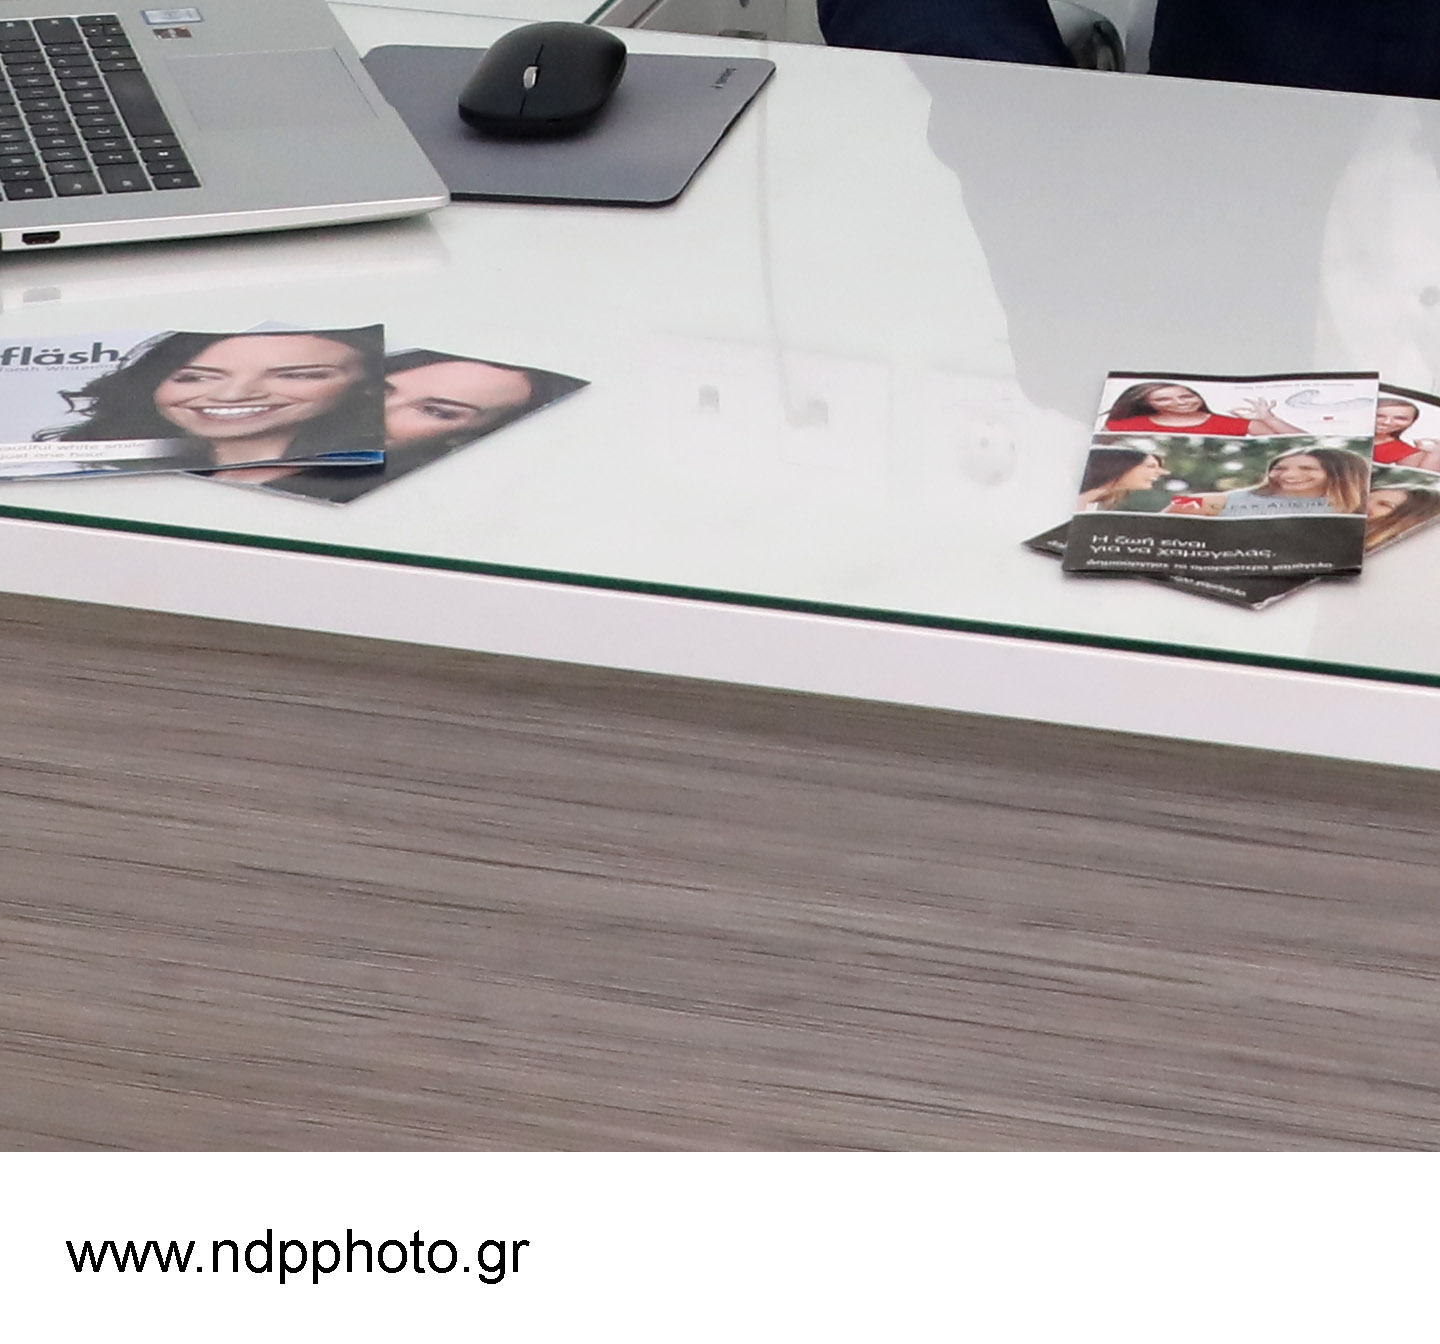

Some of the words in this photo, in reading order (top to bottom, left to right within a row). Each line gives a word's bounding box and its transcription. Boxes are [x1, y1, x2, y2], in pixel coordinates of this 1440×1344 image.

[1092, 535, 1109, 545] Η
[1114, 536, 1154, 547] ζωή
[1090, 545, 1120, 555] για
[1127, 546, 1151, 555] να
